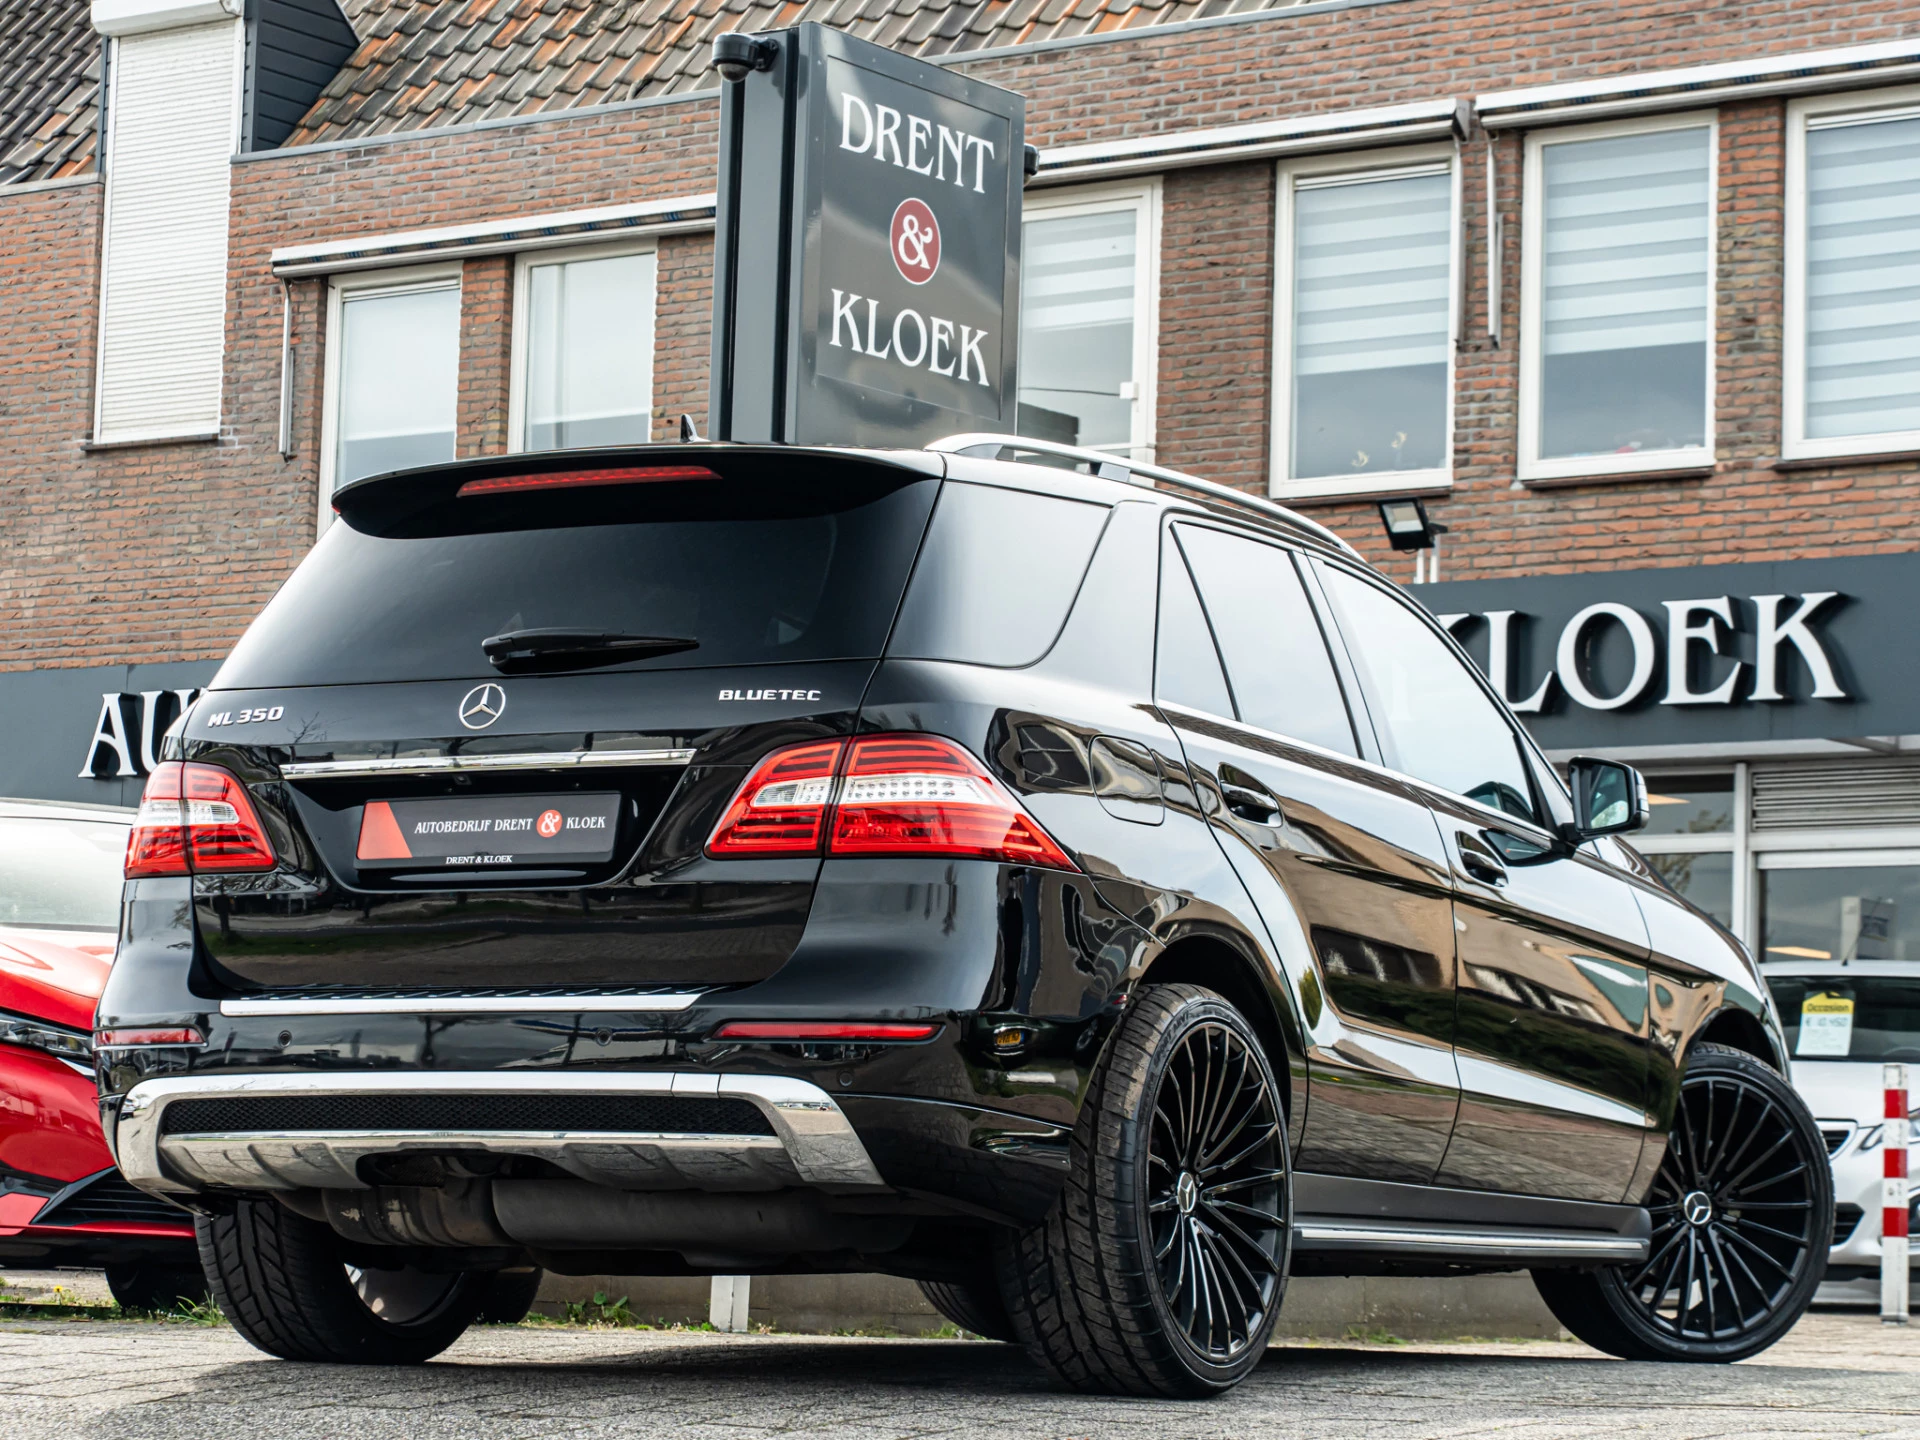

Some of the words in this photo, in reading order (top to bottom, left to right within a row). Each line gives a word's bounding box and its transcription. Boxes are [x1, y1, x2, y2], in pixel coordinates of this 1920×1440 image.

[839, 92, 995, 194] DRENT
[898, 214, 933, 270] &
[829, 288, 990, 386] KLOEK
[718, 689, 821, 701] BLUETEC
[77, 688, 206, 778] AU
[207, 711, 234, 728] ML
[236, 706, 284, 725] 350
[414, 819, 491, 834] AUTOBEDRIJF
[494, 818, 533, 831] DRENT
[541, 812, 559, 833] &
[566, 816, 606, 829] KLOEK
[446, 855, 474, 864] DRENT
[483, 854, 513, 864] KLOEK
